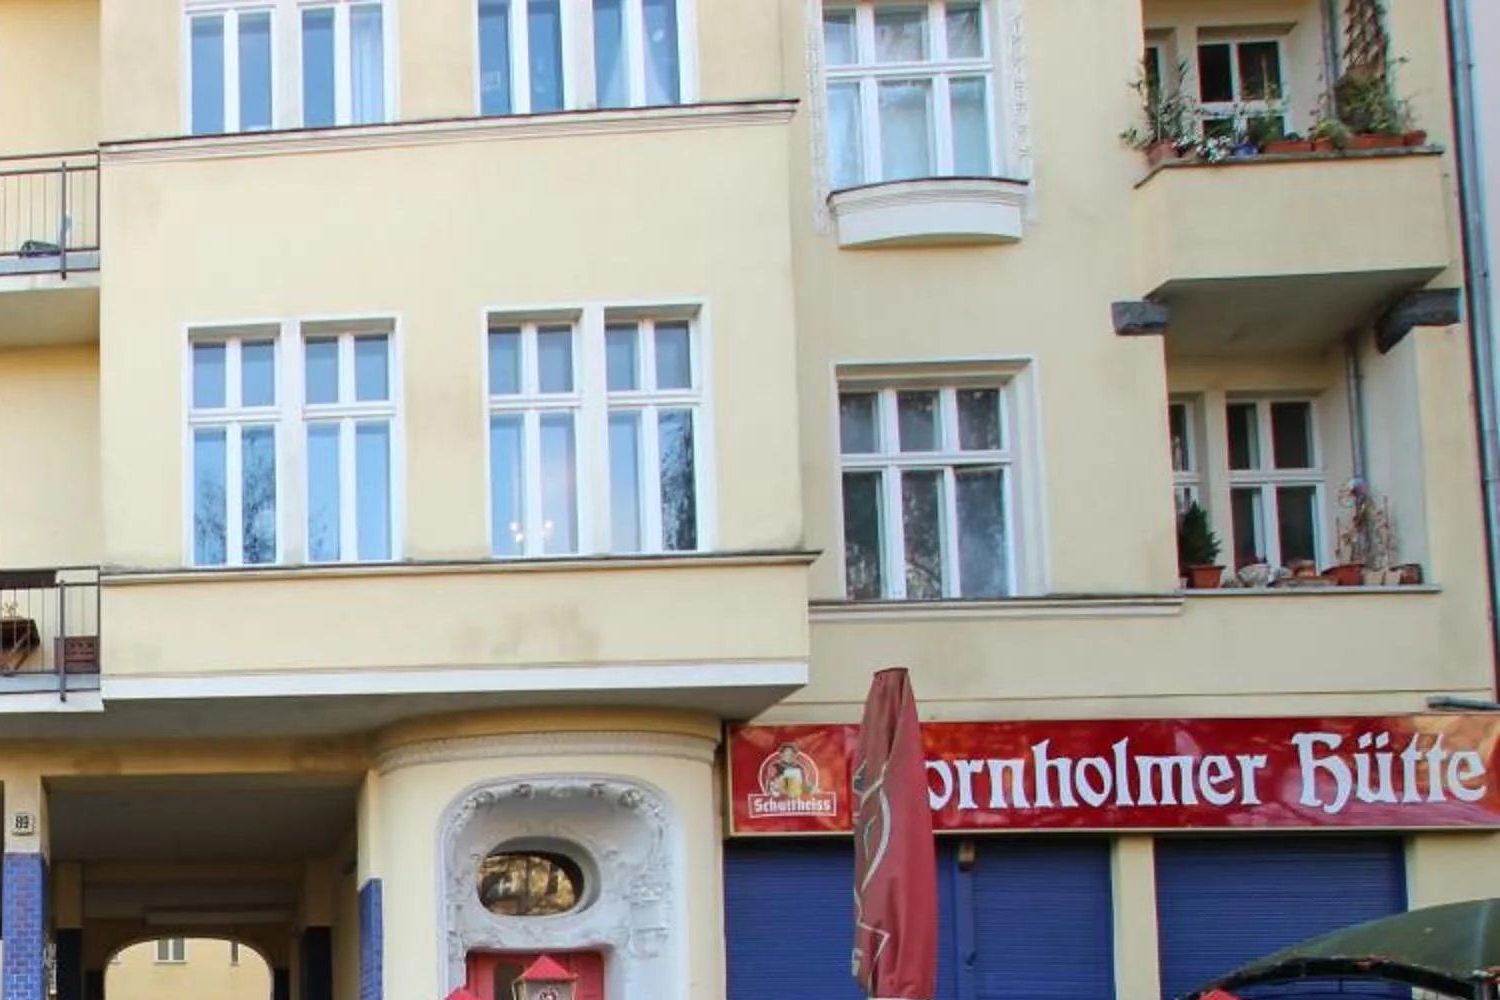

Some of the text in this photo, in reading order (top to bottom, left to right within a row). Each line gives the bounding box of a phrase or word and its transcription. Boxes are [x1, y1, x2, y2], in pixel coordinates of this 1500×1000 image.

[924, 731, 1487, 814] ornholmer Hütte
[753, 797, 831, 812] Schultheiss
